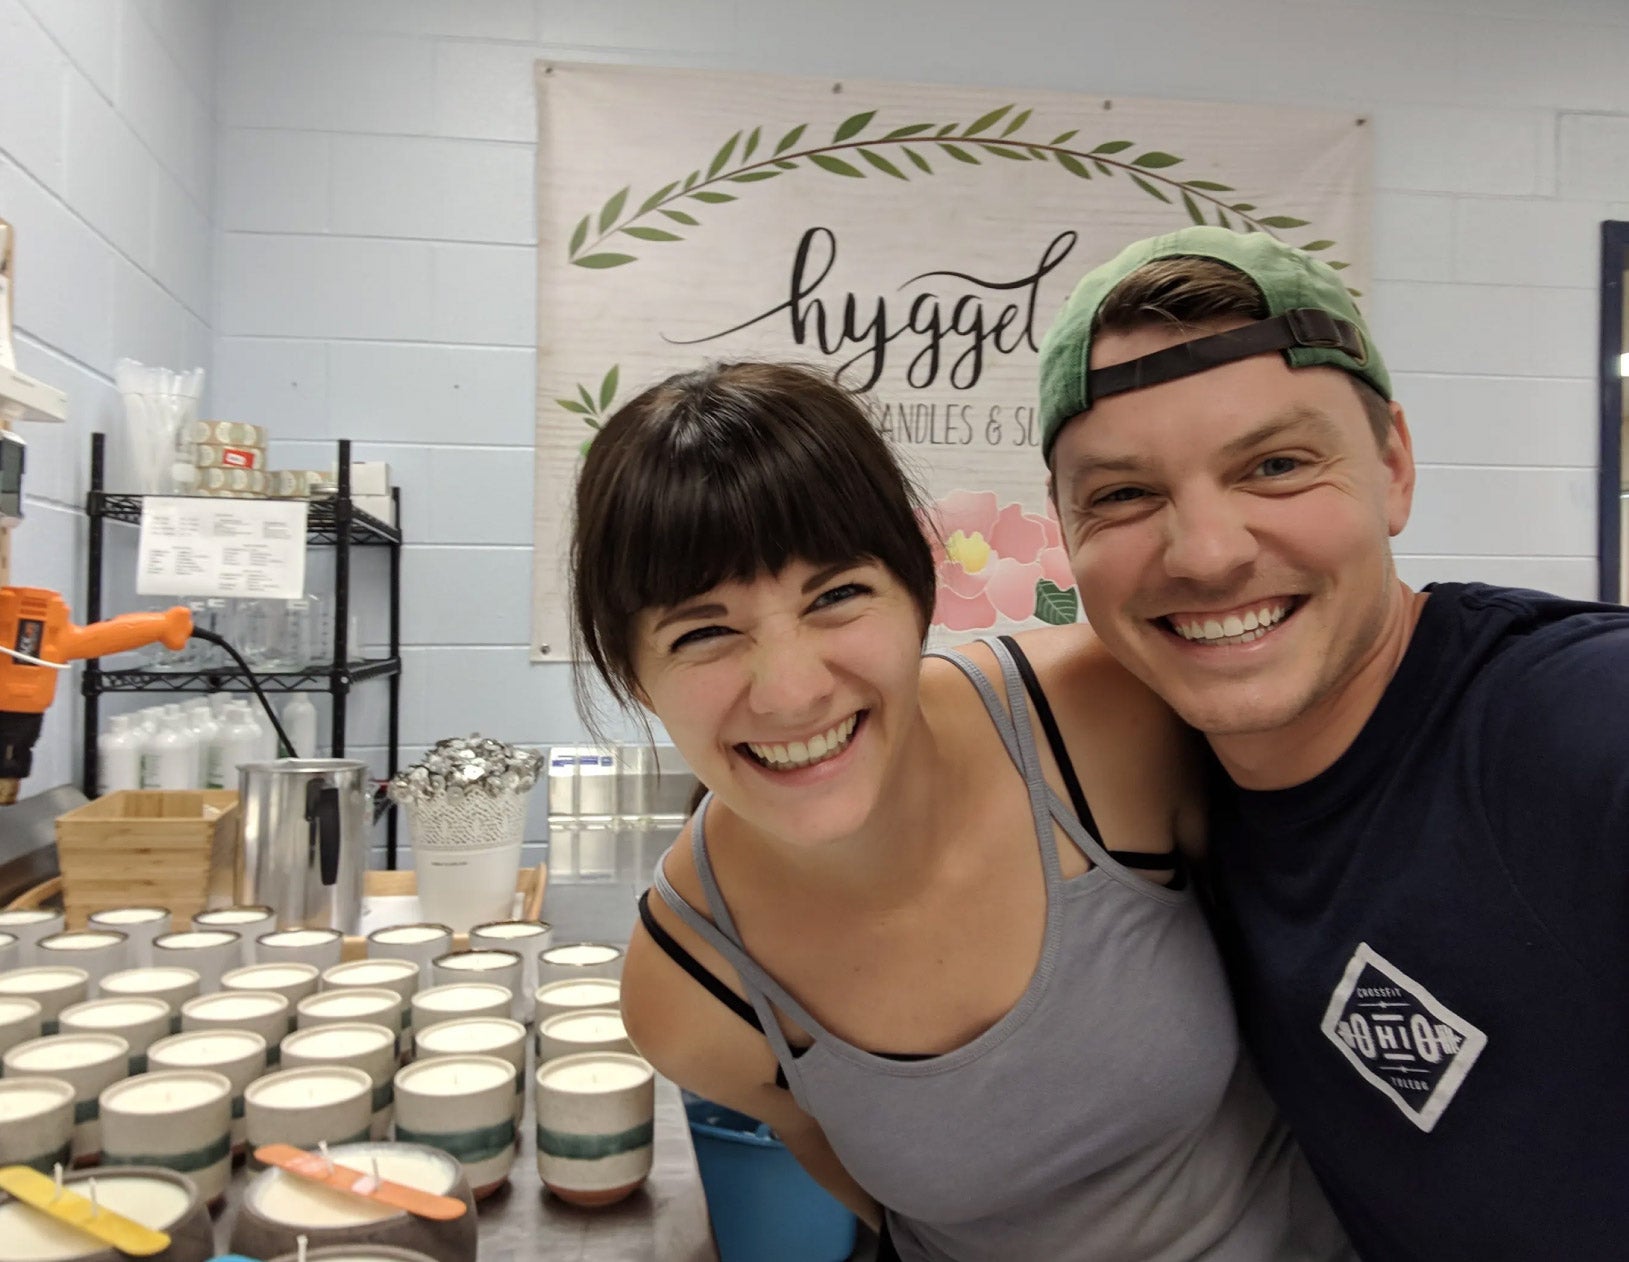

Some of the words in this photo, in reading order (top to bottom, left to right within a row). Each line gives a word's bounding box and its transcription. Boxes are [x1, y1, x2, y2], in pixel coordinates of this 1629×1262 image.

[660, 227, 1078, 393] hyggel
[871, 403, 973, 445] ANDLES
[985, 405, 1003, 446] &
[1013, 406, 1040, 447] SU
[1356, 987, 1402, 999] CROSSFIT
[1349, 1012, 1443, 1065] OHIO
[1390, 1076, 1430, 1091] TOLEDO
